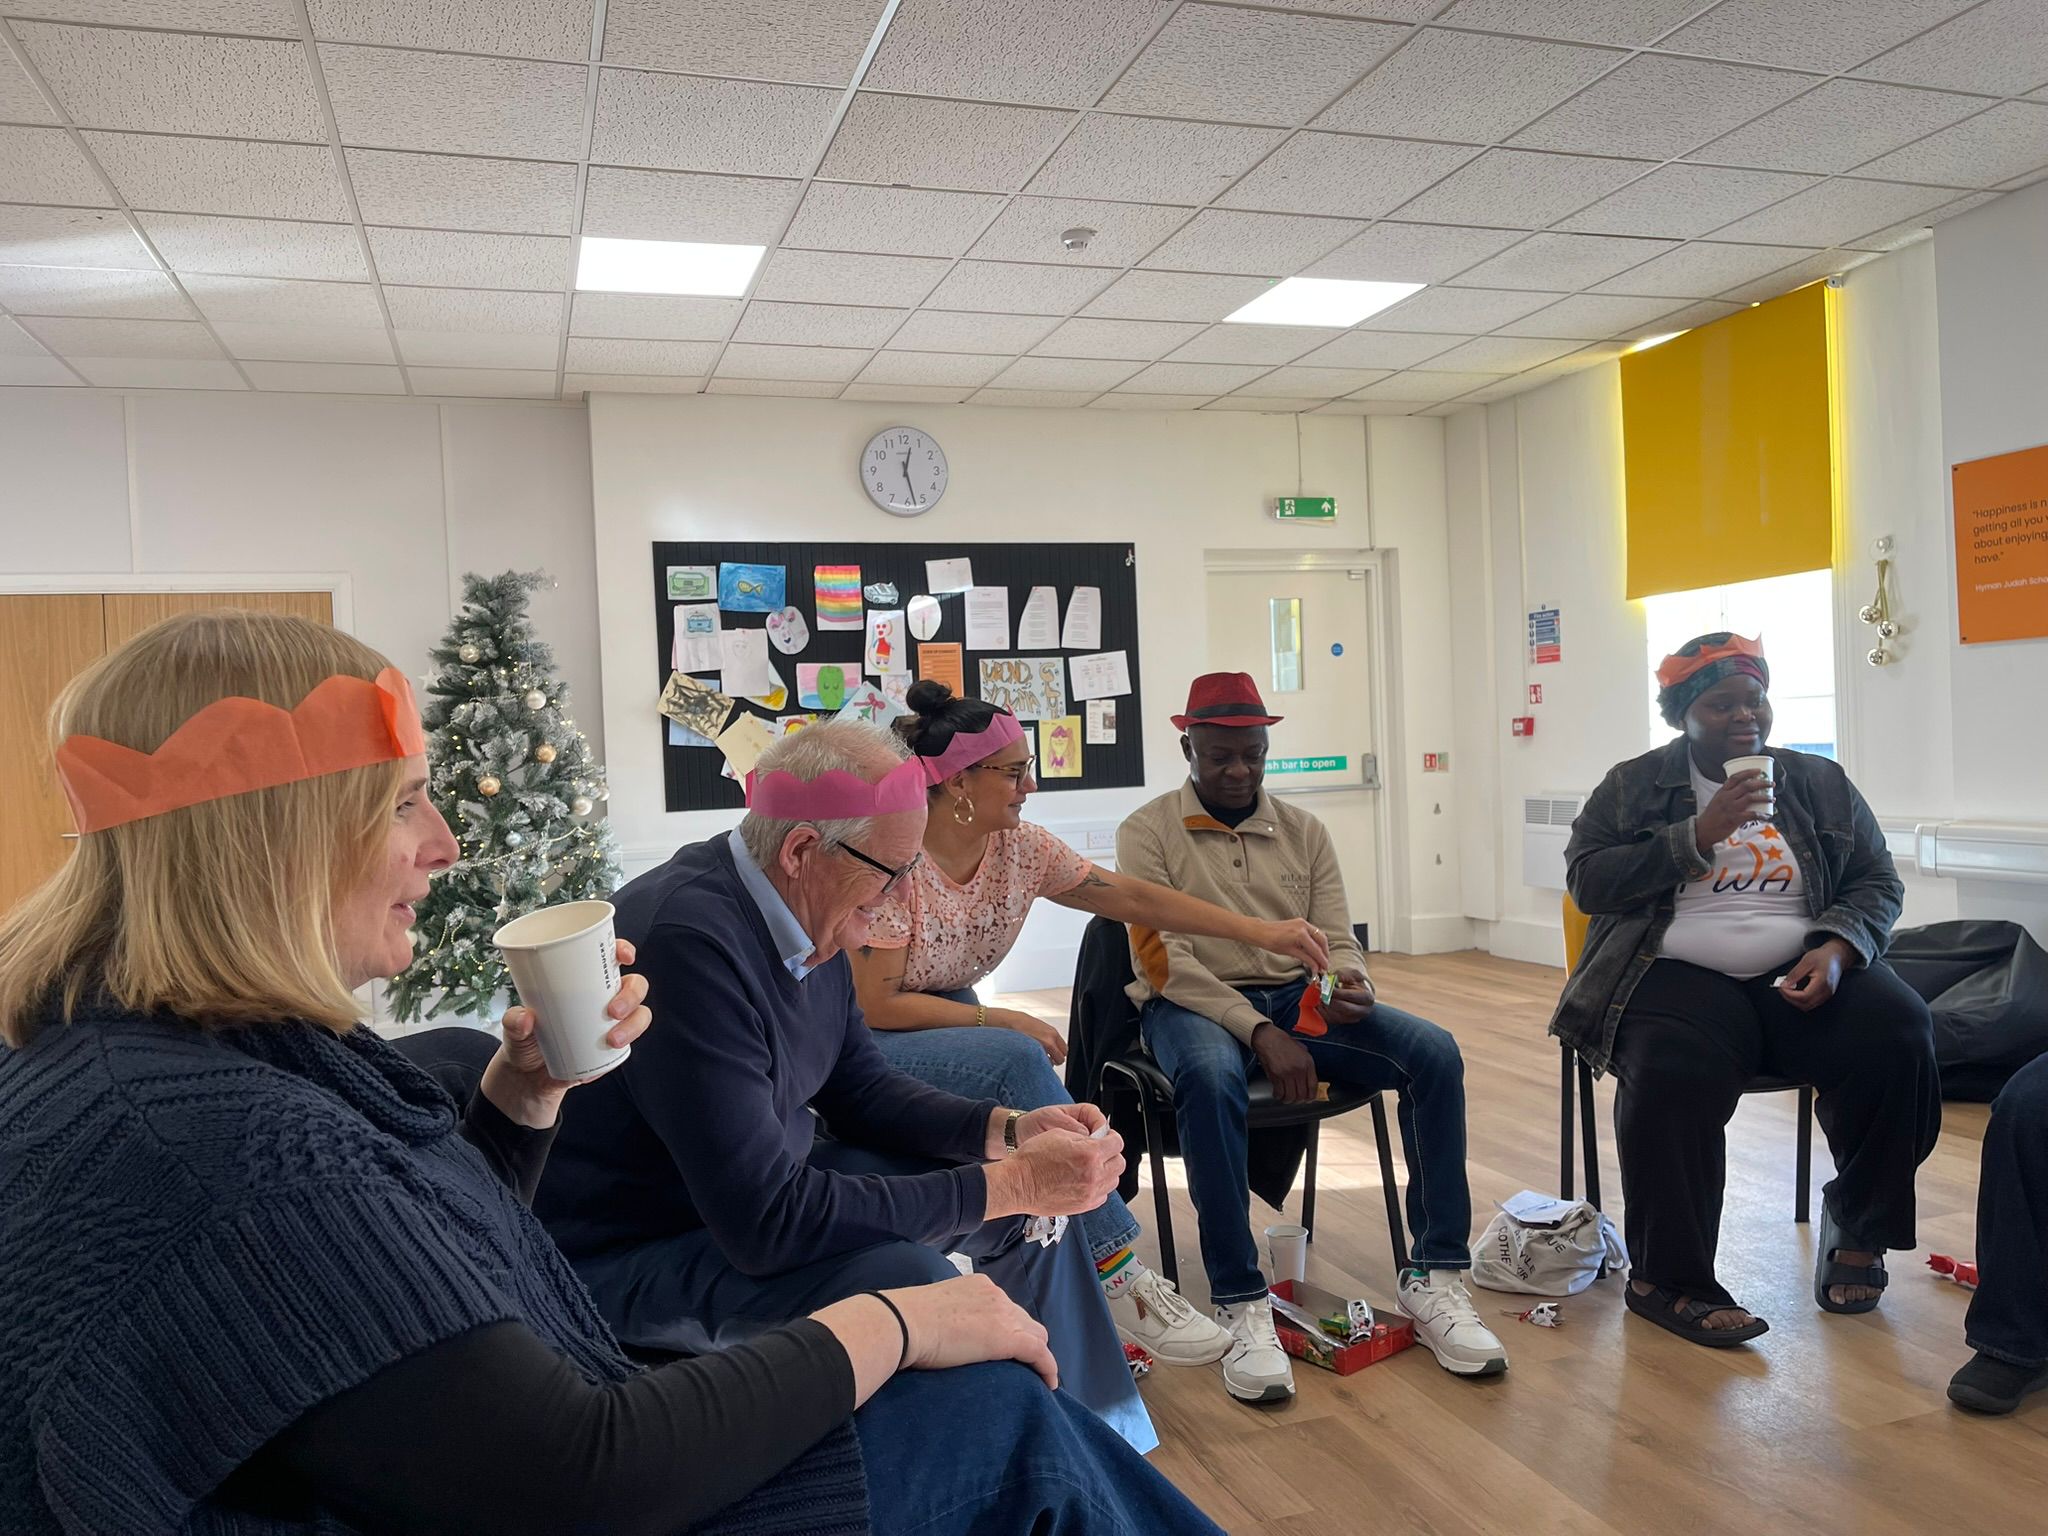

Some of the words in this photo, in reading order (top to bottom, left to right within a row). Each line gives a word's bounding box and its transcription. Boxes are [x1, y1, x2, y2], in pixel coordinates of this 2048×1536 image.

[885, 439, 894, 449] 11
[898, 435, 910, 445] 12
[917, 438, 921, 448] 1
[875, 450, 886, 461] 10
[927, 450, 934, 460] 2
[870, 465, 877, 476] 9
[933, 466, 940, 476] 3
[876, 482, 884, 492] 8
[930, 482, 936, 491] 4
[889, 493, 896, 503] 7
[904, 497, 911, 507] 6
[919, 494, 927, 504] 5
[2029, 499, 2038, 509] is
[1973, 521, 2008, 537] getting
[2010, 517, 2022, 528] all
[2024, 514, 2043, 528] you
[1974, 537, 2002, 550] about
[2005, 530, 2048, 546] enjoying
[1975, 582, 2002, 592] Hyman
[1281, 760, 1297, 769] bar
[1300, 760, 1310, 769] to
[1312, 759, 1336, 769] open
[600, 942, 611, 990] STARBUCKS
[1104, 1271, 1133, 1295] ANA
